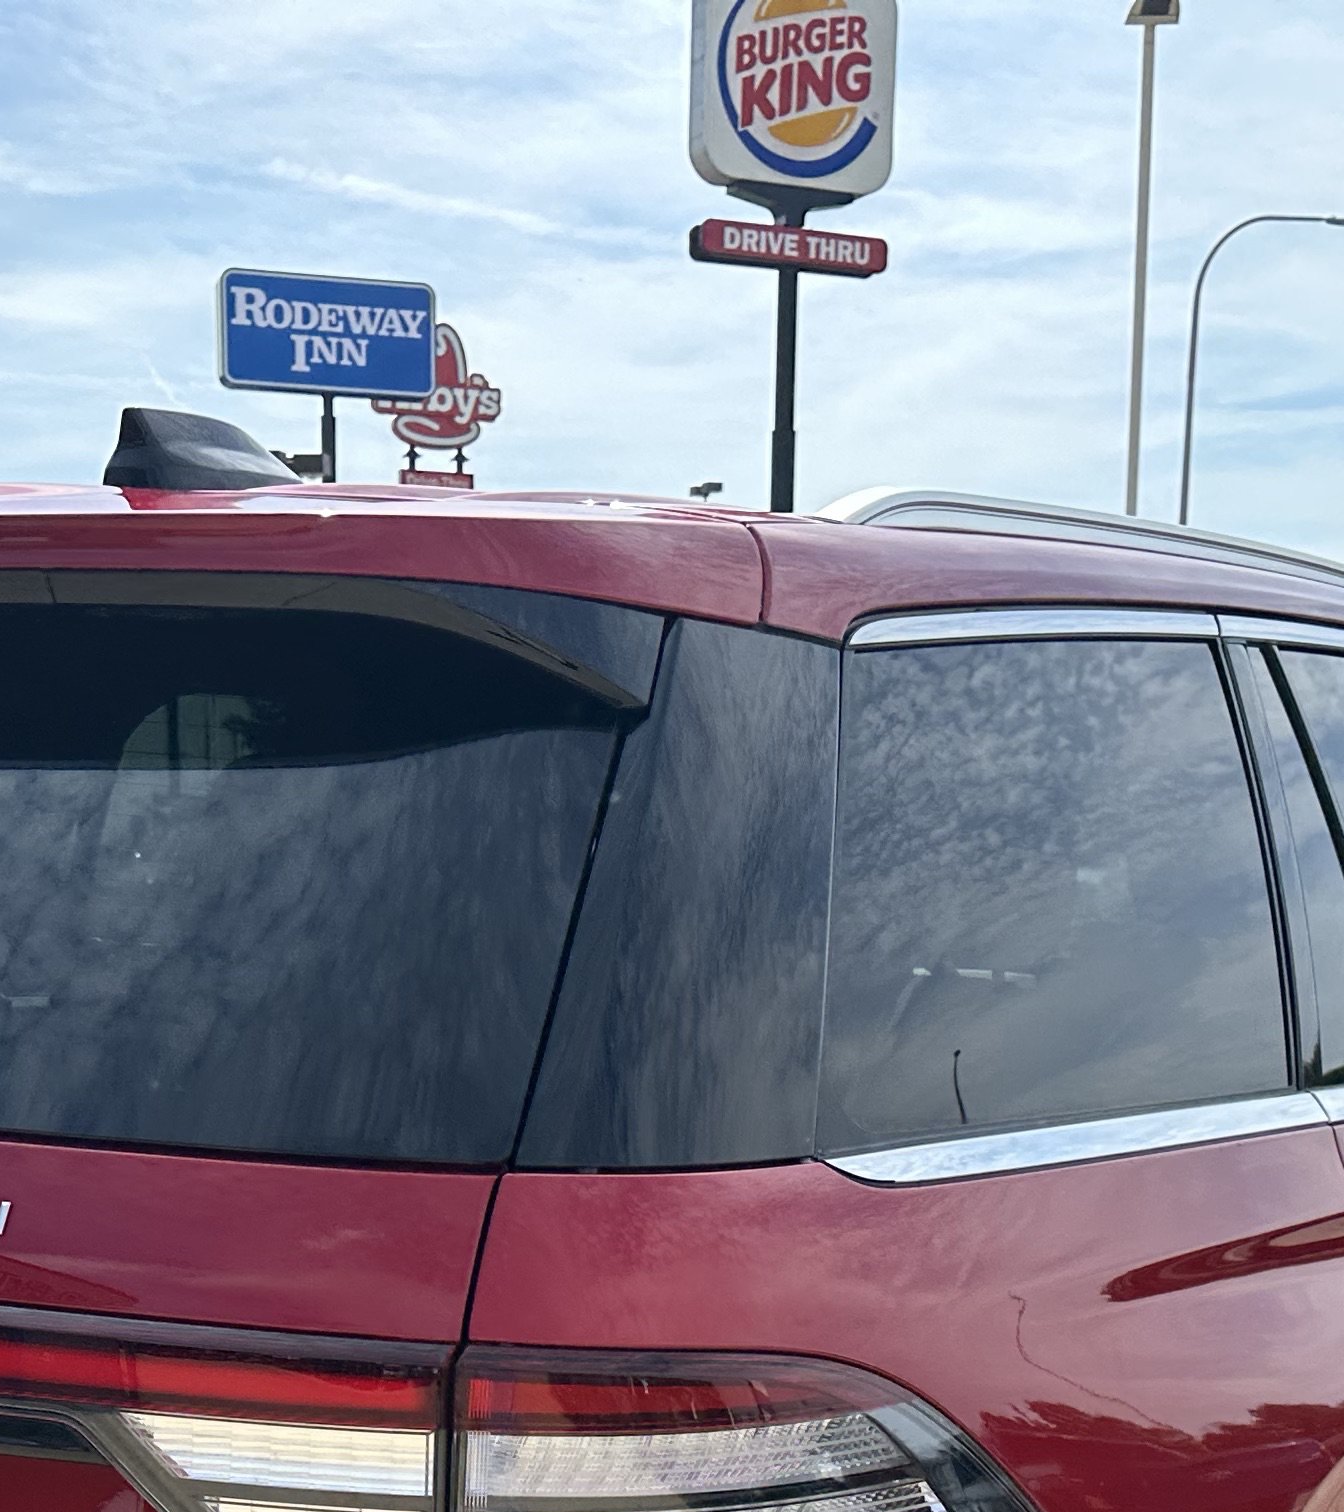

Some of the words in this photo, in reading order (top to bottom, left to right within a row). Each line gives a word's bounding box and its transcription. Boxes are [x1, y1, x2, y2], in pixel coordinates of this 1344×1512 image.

[735, 15, 868, 74] BURGER
[741, 52, 872, 128] KING
[723, 226, 800, 257] DRIVE
[807, 236, 870, 265] THRU
[230, 286, 427, 339] RODEWAY
[290, 334, 369, 372] INN
